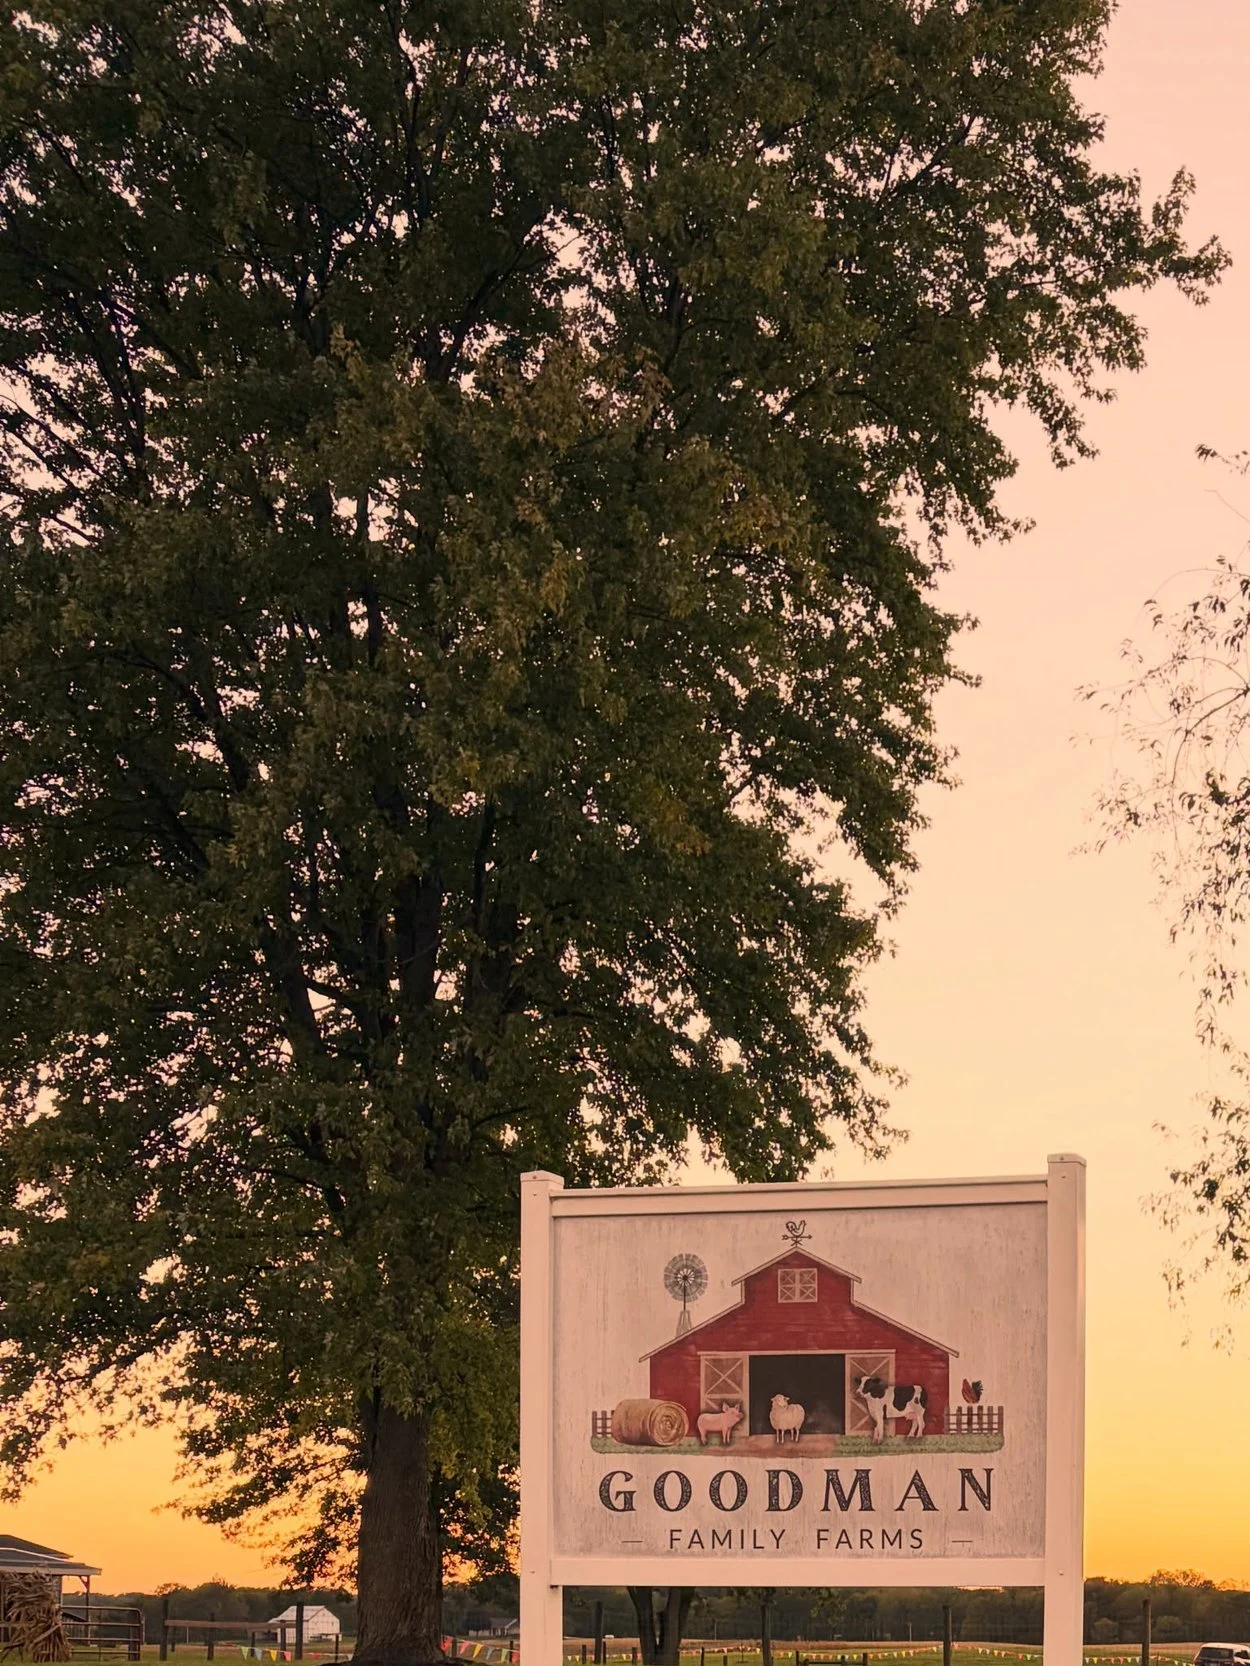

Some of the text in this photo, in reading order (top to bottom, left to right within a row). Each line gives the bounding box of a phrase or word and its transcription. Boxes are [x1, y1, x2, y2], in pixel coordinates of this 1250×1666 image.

[598, 1467, 995, 1513] GOODMAN
[668, 1528, 925, 1551] FAMILY FARMS
